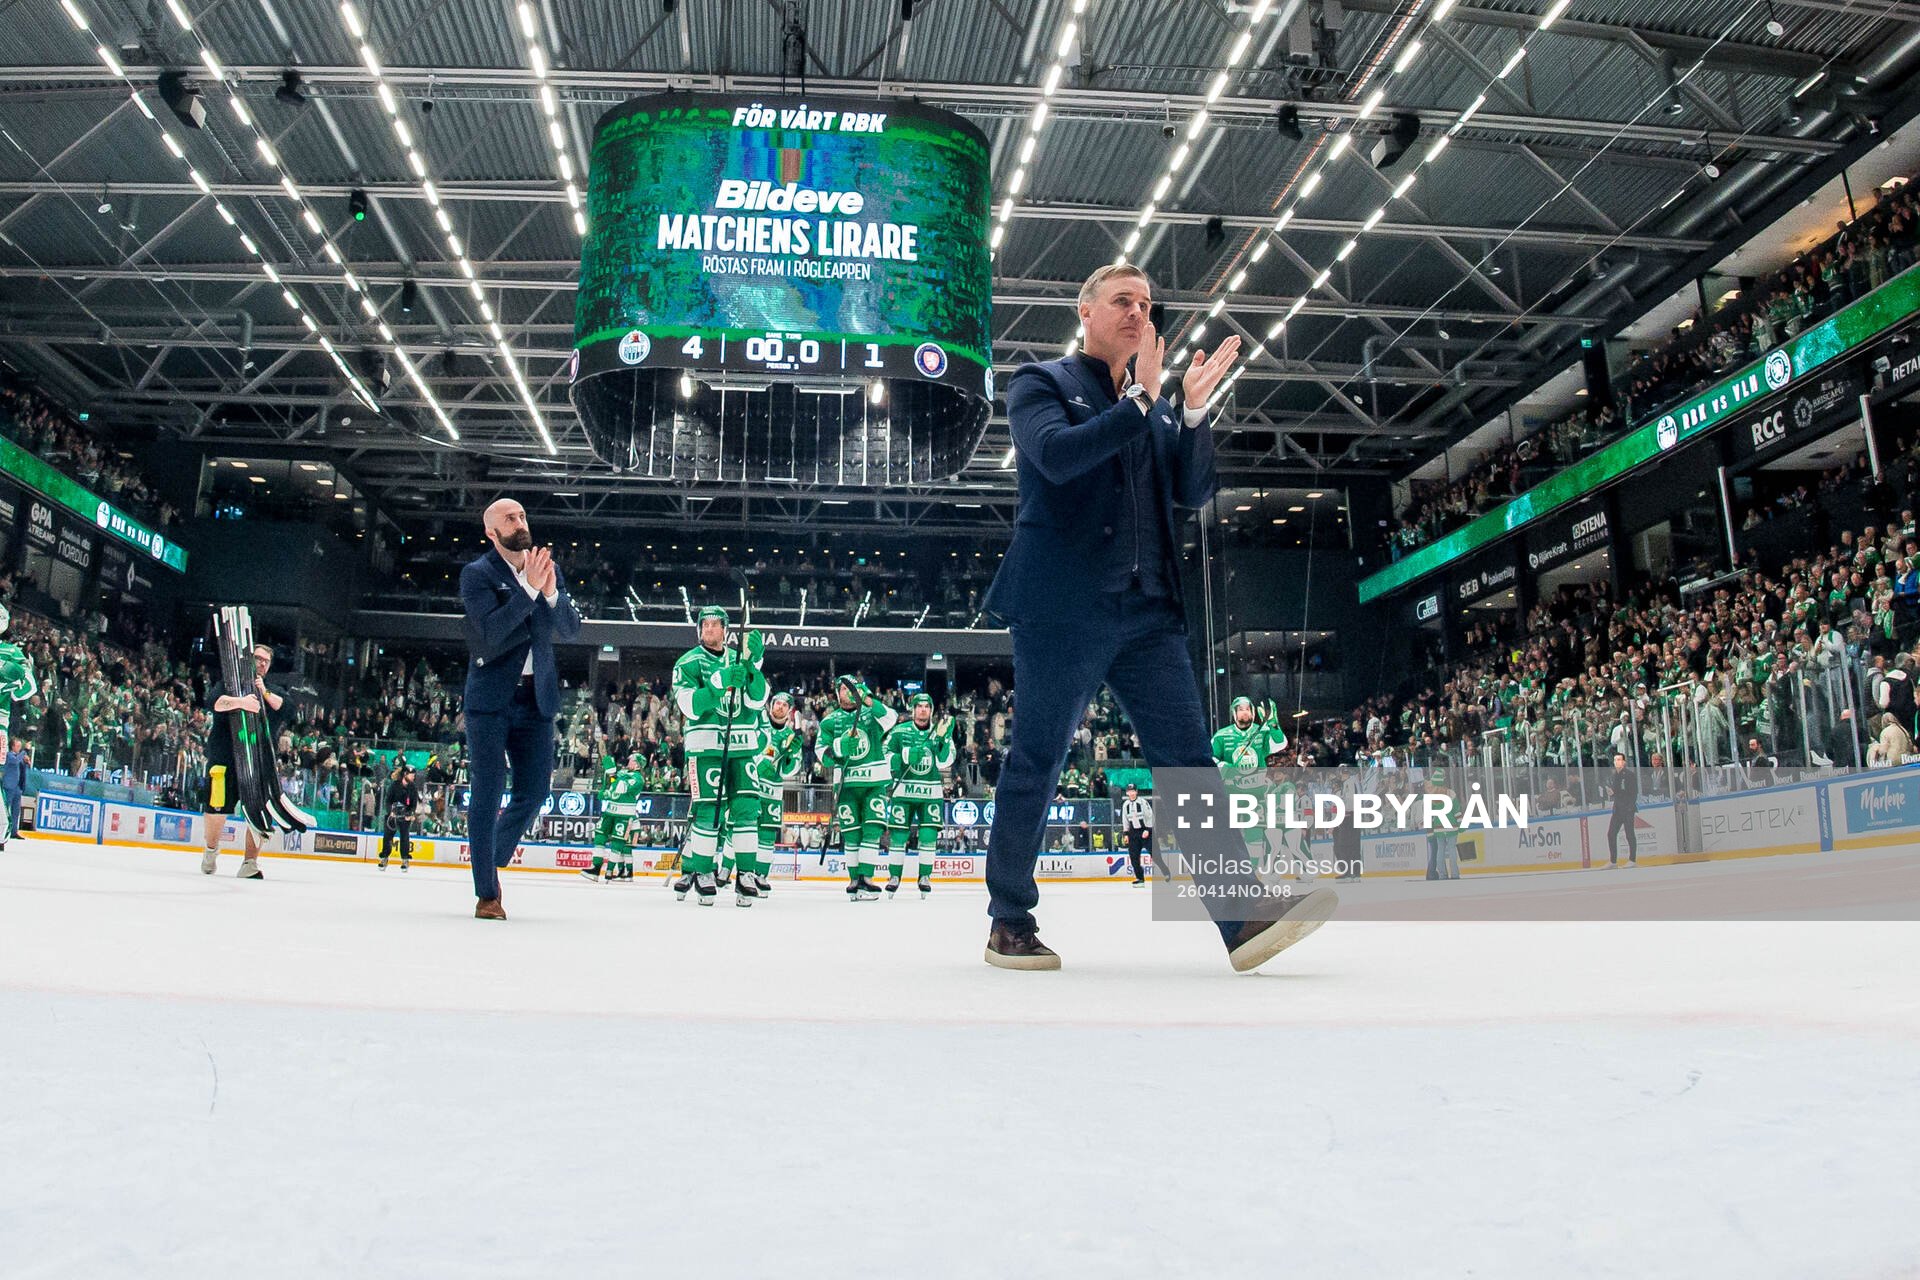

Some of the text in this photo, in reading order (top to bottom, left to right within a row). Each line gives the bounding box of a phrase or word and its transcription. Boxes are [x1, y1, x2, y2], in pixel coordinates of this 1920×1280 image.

[731, 104, 887, 133] FÖR VÅRT RBK
[714, 179, 865, 215] Bildeve
[656, 214, 919, 262] MATCHENS LIRARE
[701, 256, 749, 275] RÖSTAS
[750, 259, 785, 277] FRAM
[793, 262, 871, 281] RÖGLEAPPEN
[681, 335, 704, 359] 4
[746, 337, 820, 363] 00.0
[864, 342, 884, 368] 1
[1682, 403, 1707, 430] RBK
[1751, 410, 1785, 446] RCC
[31, 502, 52, 530] GPA
[1580, 511, 1608, 536] STENA
[1459, 578, 1479, 599] SEB
[782, 633, 830, 648] Arena
[904, 784, 932, 796] MAXI
[1518, 826, 1562, 849] AirSon
